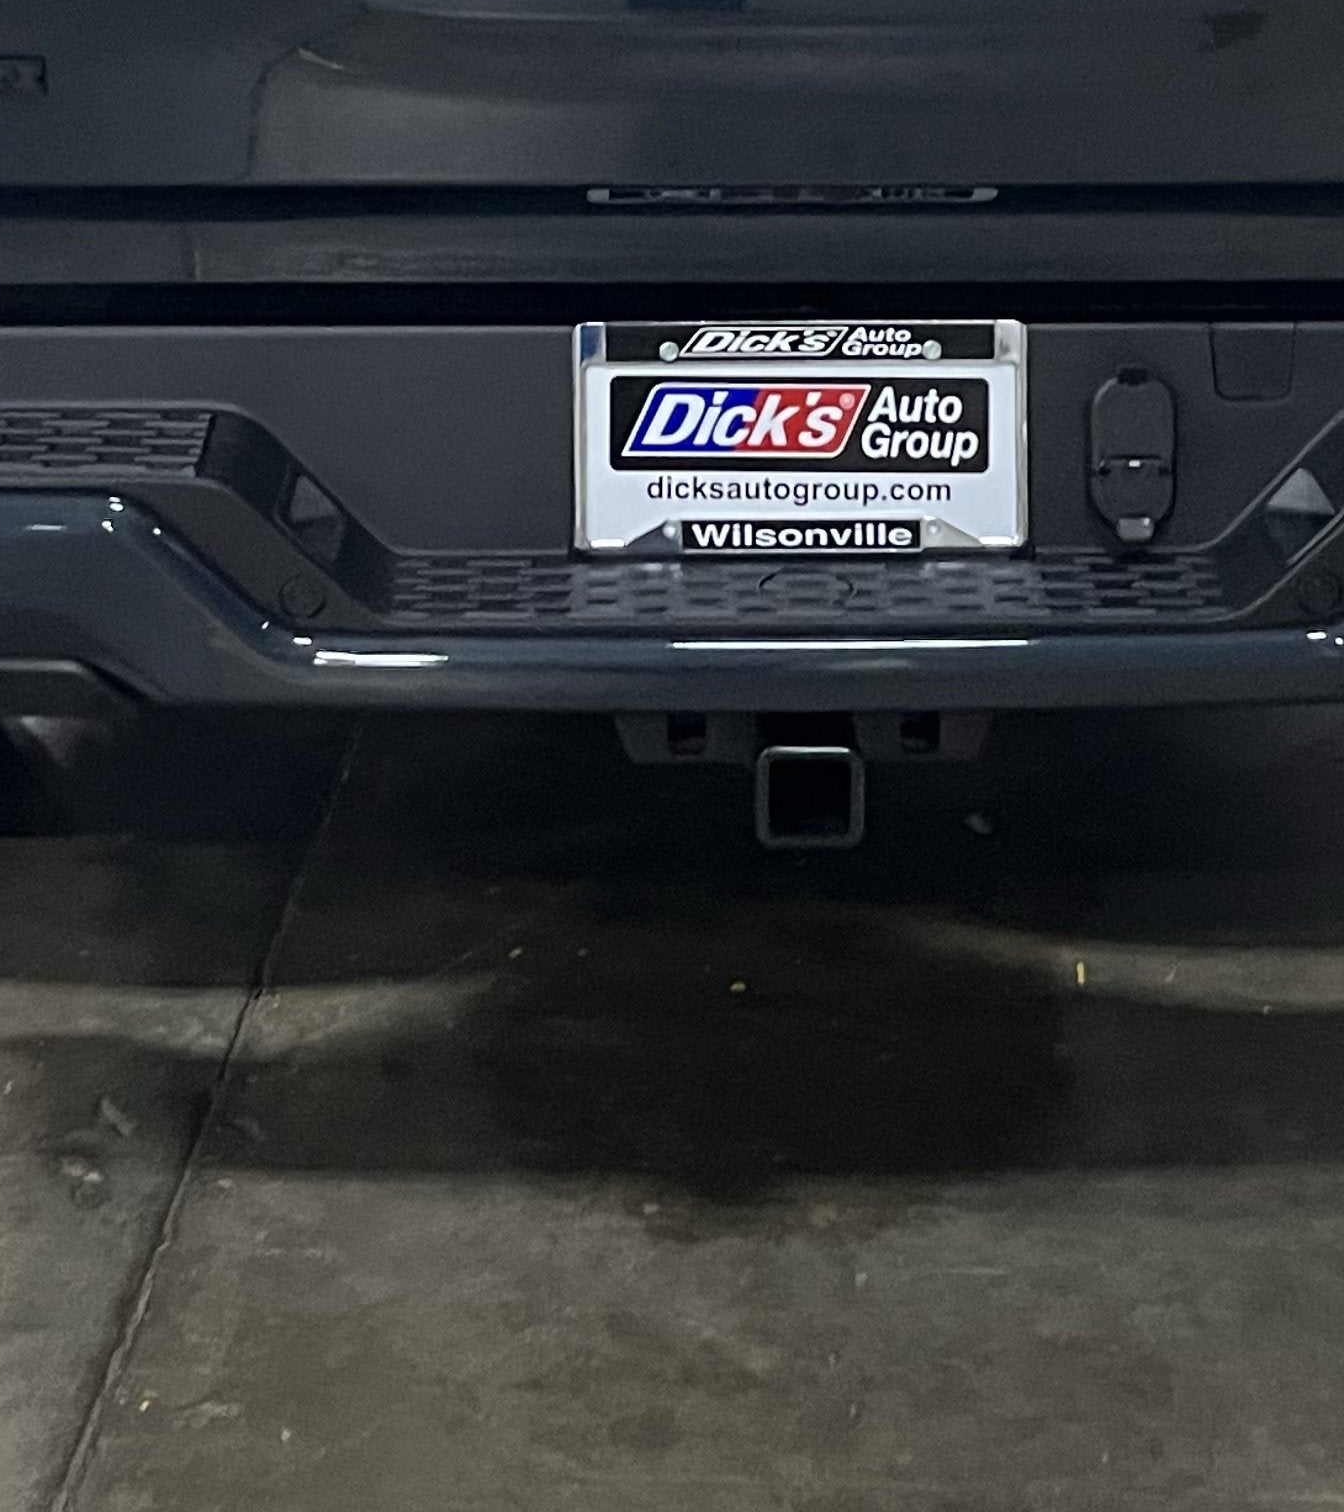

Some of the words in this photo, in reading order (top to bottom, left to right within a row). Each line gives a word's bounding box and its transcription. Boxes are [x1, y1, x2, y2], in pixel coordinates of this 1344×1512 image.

[693, 329, 836, 354] Dick's
[846, 326, 912, 343] Auto
[842, 340, 923, 359] Group
[641, 390, 842, 448] Dick's
[866, 386, 963, 424] Auto
[860, 427, 979, 466] Group
[646, 476, 953, 506] dicksautogroup.com
[692, 522, 913, 548] Wilsonville
